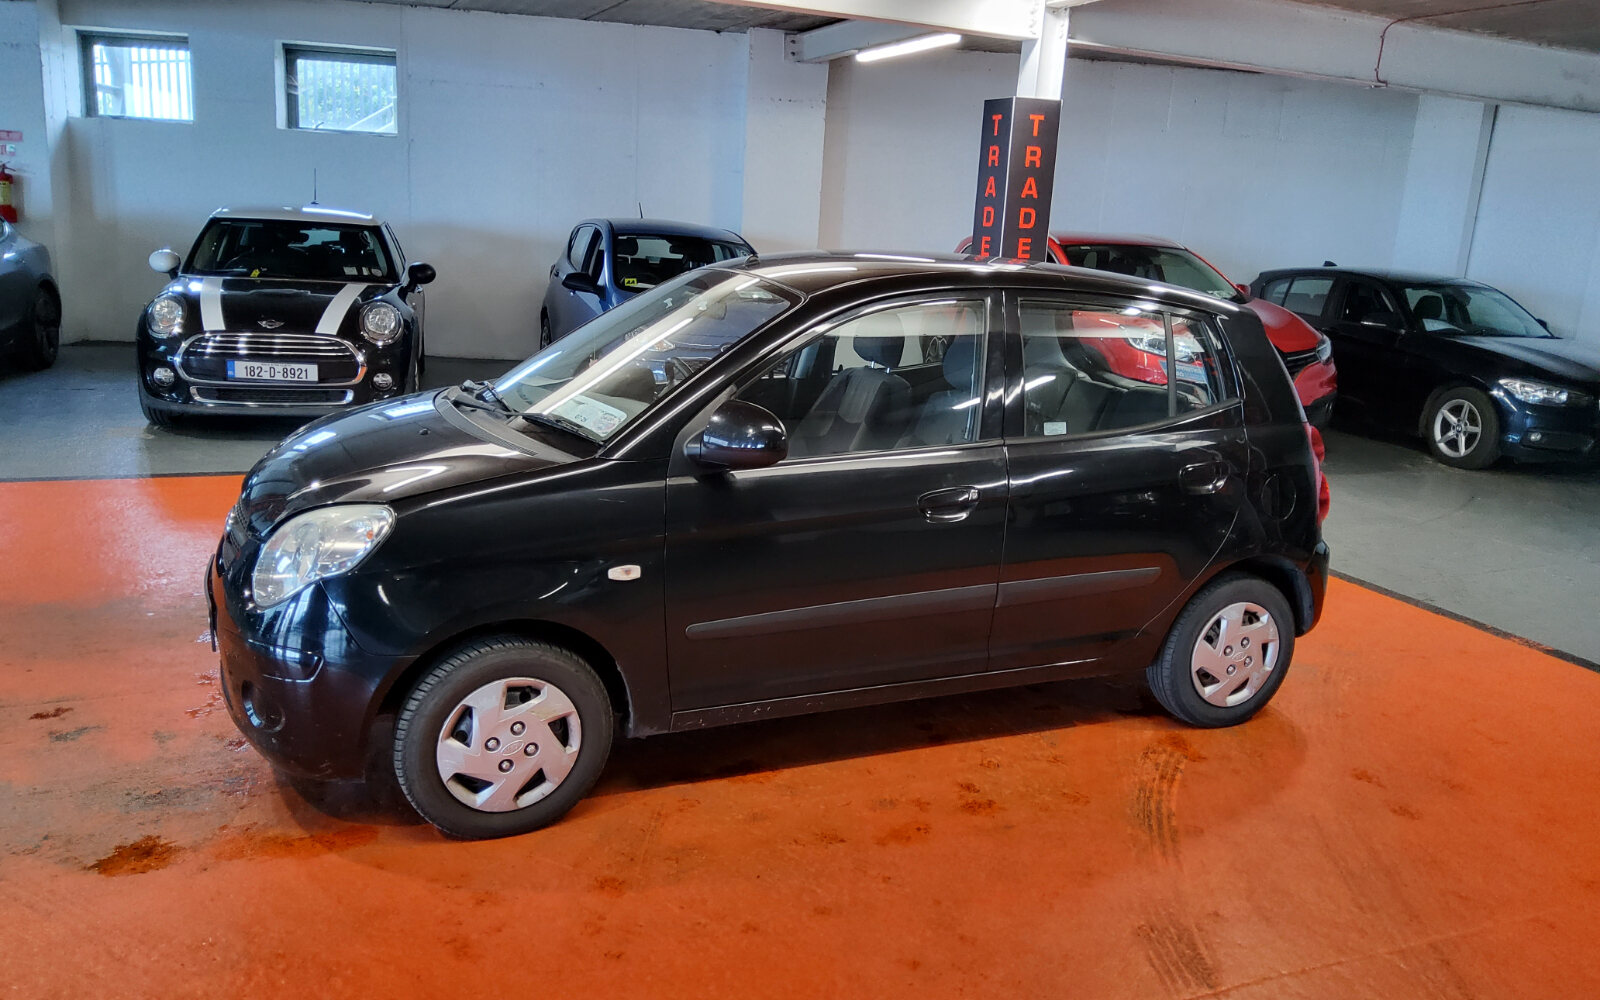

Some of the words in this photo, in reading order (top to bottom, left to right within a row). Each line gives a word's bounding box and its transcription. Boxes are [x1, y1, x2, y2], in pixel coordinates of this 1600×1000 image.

[980, 114, 1003, 257] TRADE
[1017, 114, 1045, 259] TRADE
[245, 365, 309, 379] 182-D-8921
